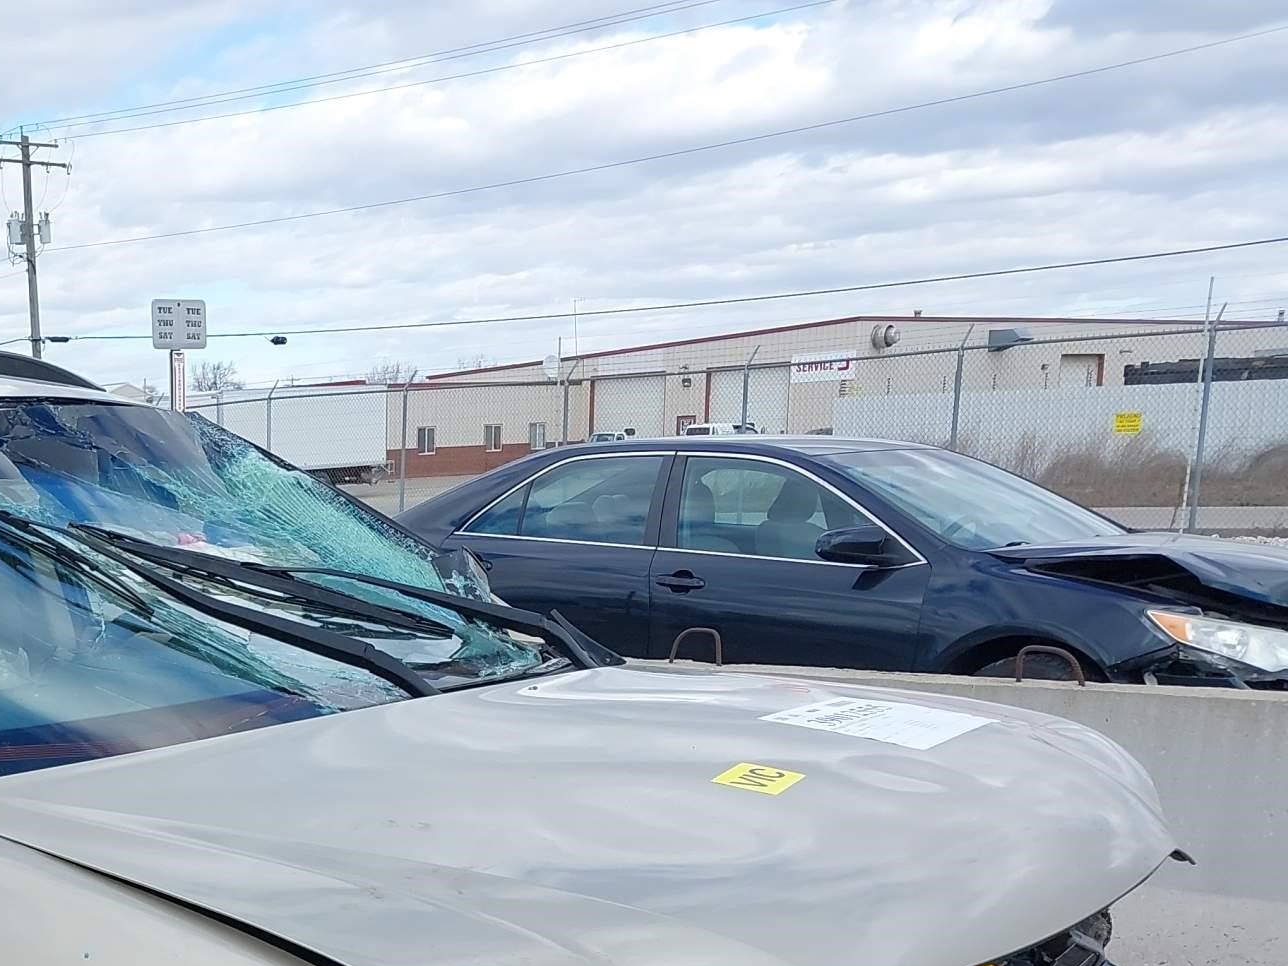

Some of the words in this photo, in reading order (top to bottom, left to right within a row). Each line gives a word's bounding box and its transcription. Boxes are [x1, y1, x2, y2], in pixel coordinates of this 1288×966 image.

[157, 306, 173, 314] TUE
[186, 307, 201, 315] TUE
[157, 319, 173, 327] THU
[185, 320, 202, 328] THU
[158, 331, 173, 340] SAT
[186, 332, 201, 340] SAT
[796, 360, 834, 372] SERVICE
[728, 767, 786, 787] VIC
